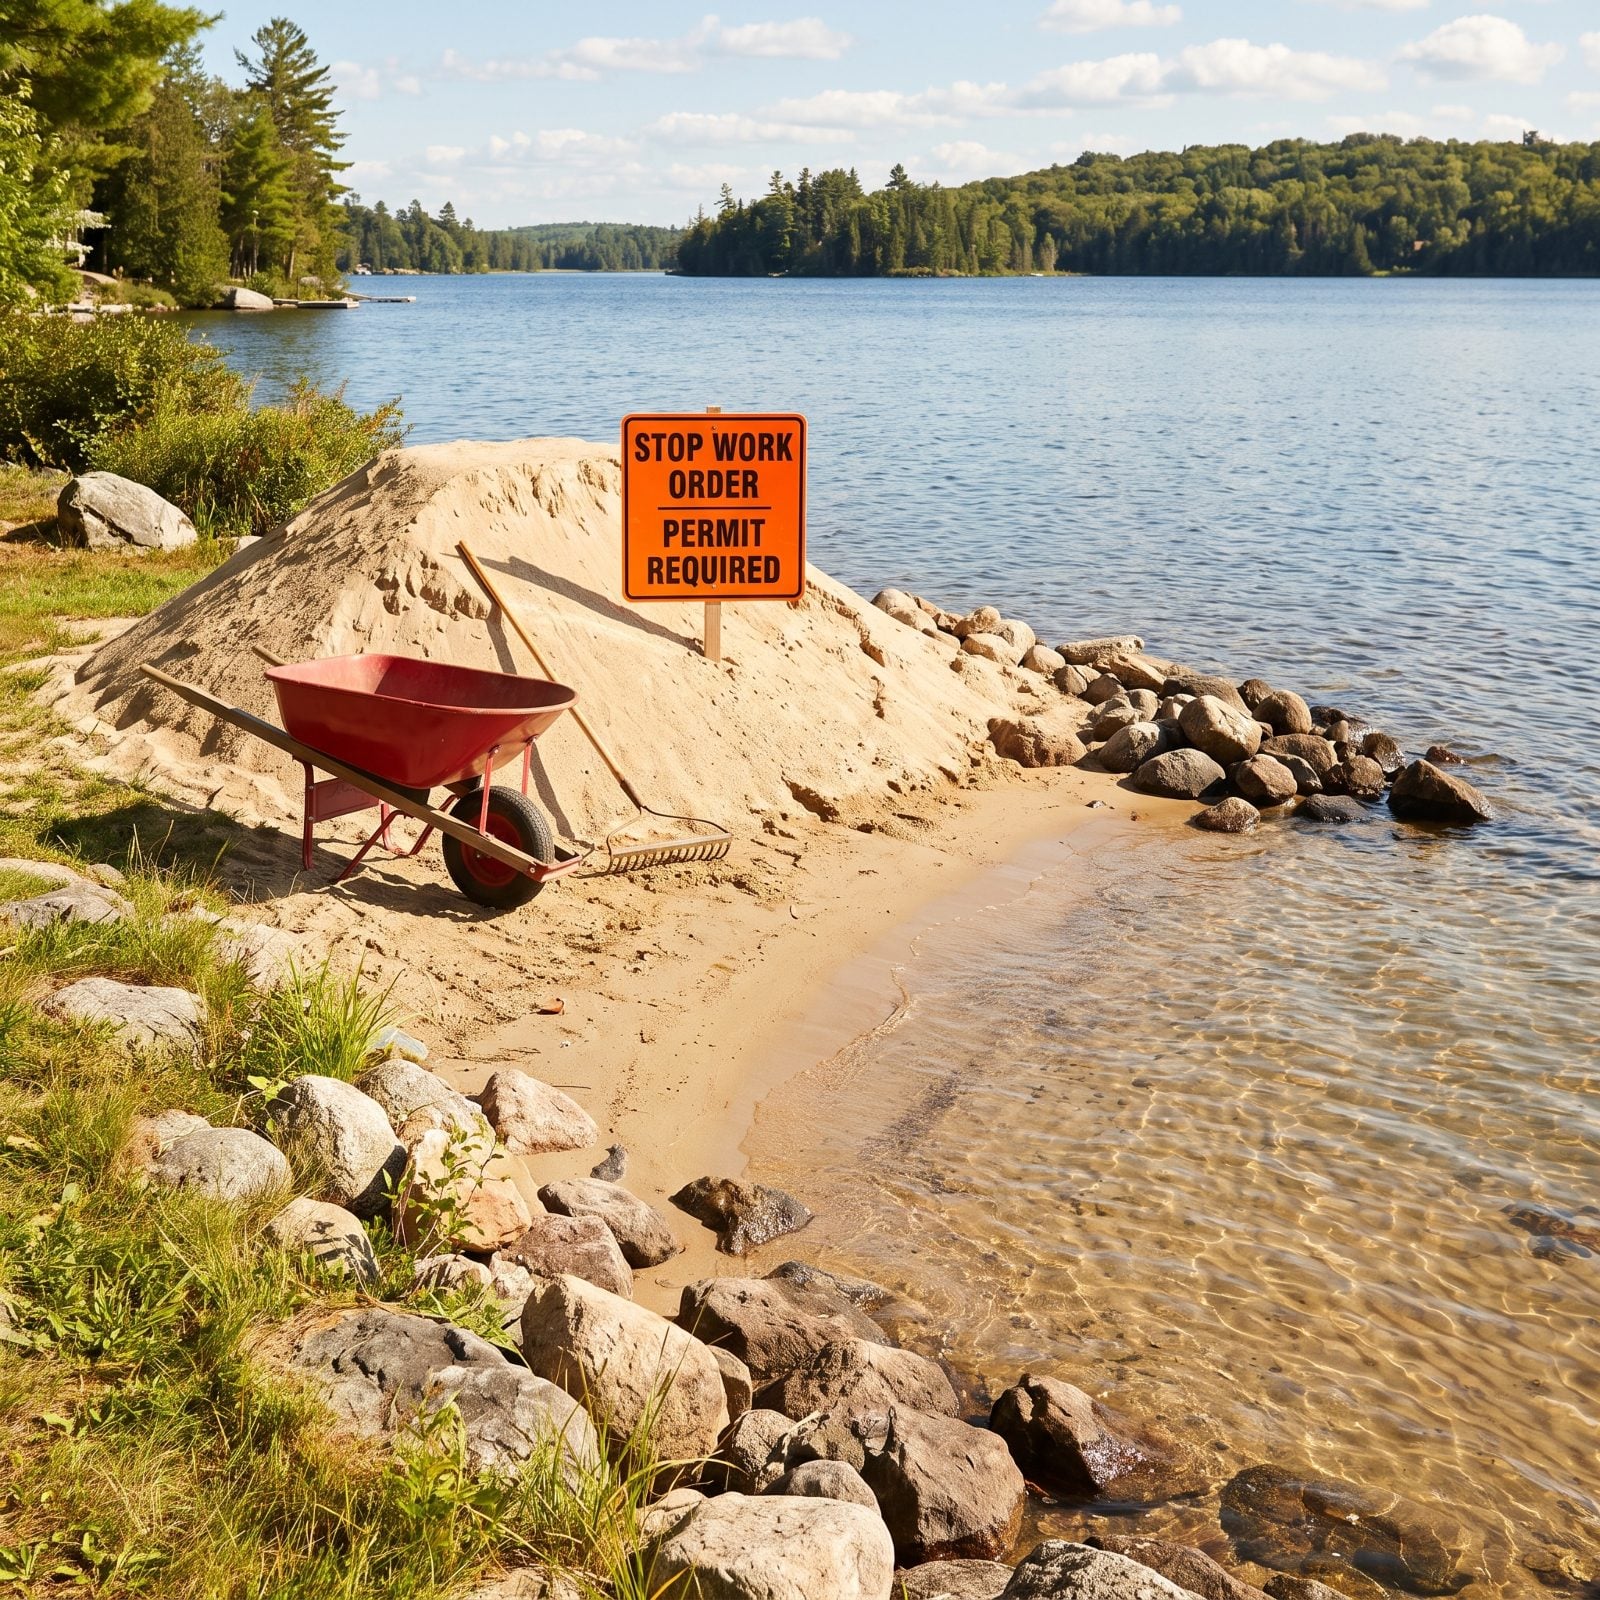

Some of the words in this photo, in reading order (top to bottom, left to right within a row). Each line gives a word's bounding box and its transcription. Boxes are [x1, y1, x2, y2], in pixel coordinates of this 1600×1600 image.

[634, 432, 704, 462] STOP
[712, 432, 793, 462] WORK
[668, 469, 759, 499] ORDER
[663, 518, 765, 548] PERMIT
[647, 555, 780, 587] REQUIRED
